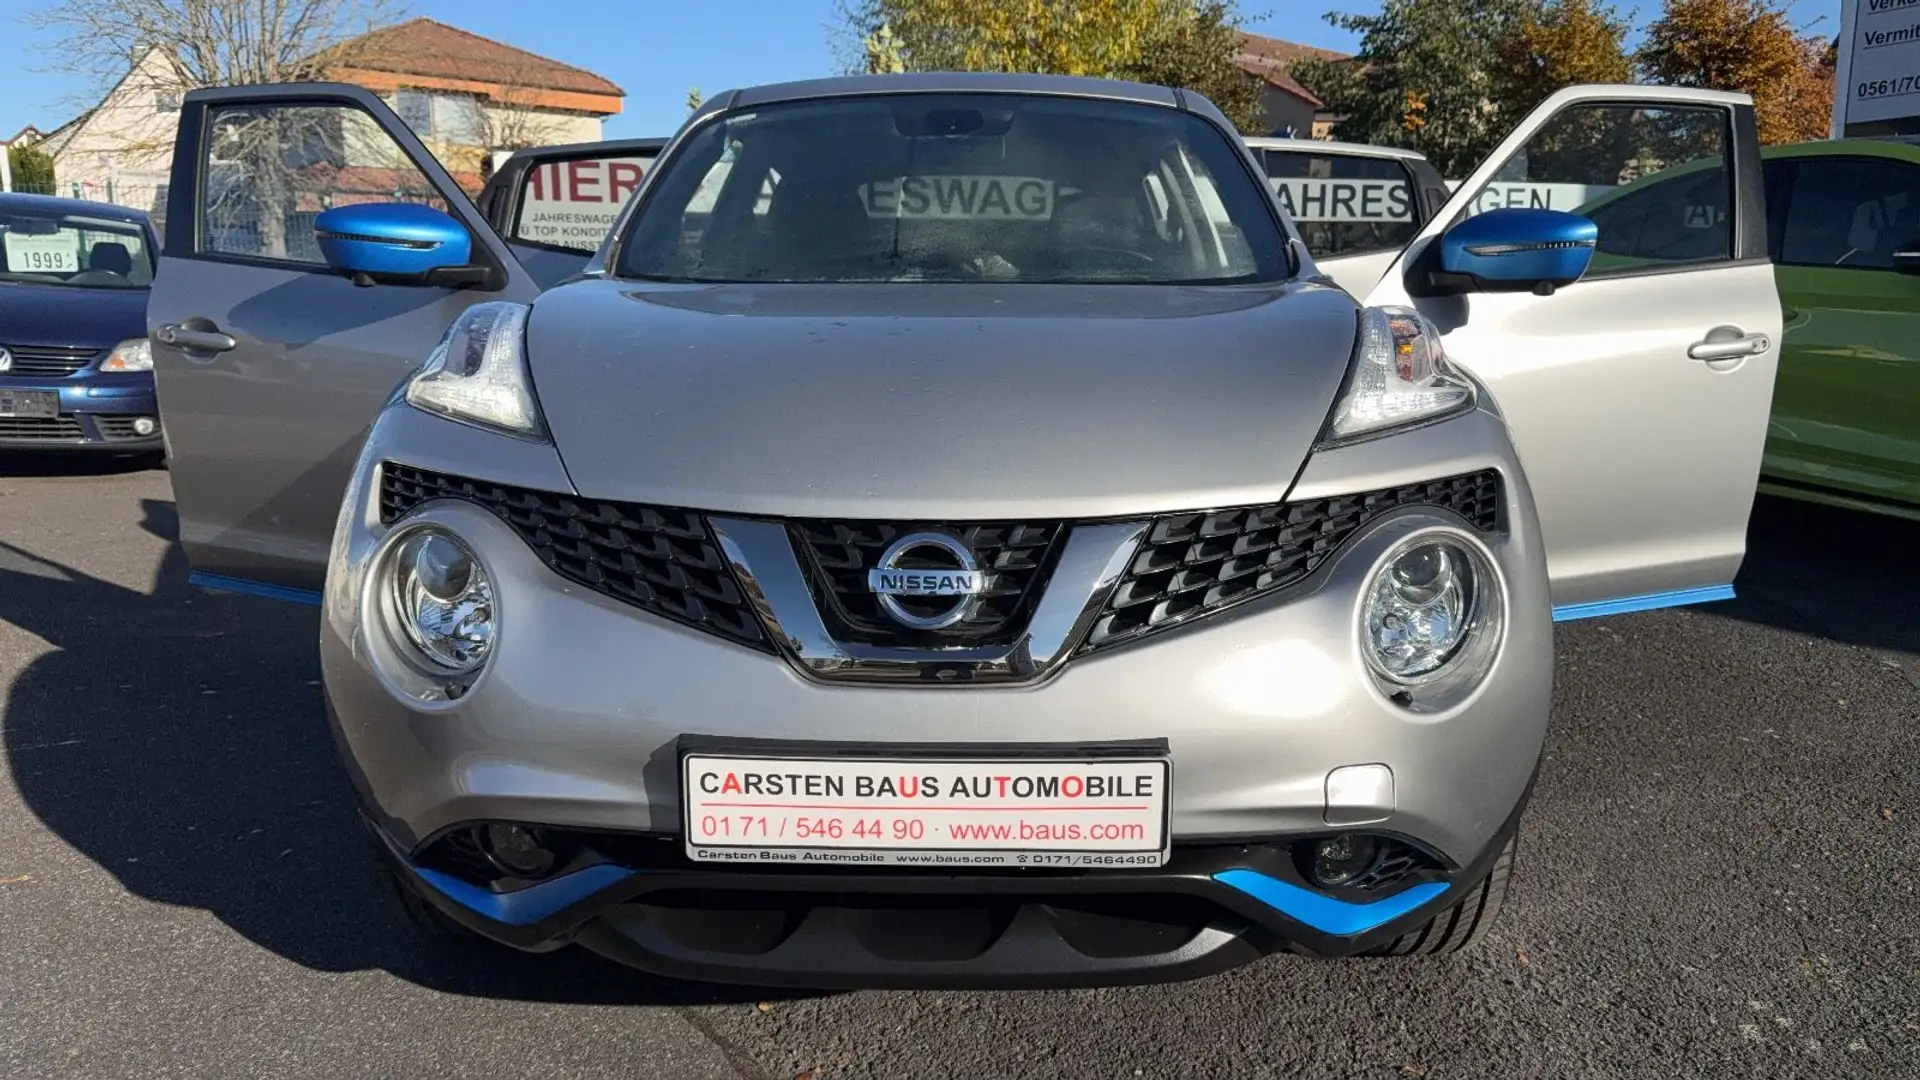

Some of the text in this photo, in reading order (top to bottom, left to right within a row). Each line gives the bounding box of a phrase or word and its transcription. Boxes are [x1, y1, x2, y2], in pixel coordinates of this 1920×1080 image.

[533, 226, 558, 236] TOP
[880, 574, 972, 590] NISSAN
[699, 772, 1153, 798] CARSTEN BAUS AUTOMOBILE
[796, 817, 843, 838] 546
[852, 819, 882, 838] 44
[893, 819, 924, 839] 90
[949, 820, 1144, 840] www.baus.com
[698, 850, 757, 860] Carsten
[760, 851, 797, 861] Baus
[802, 852, 885, 862] Automobile
[896, 854, 1005, 863] www.baus.com
